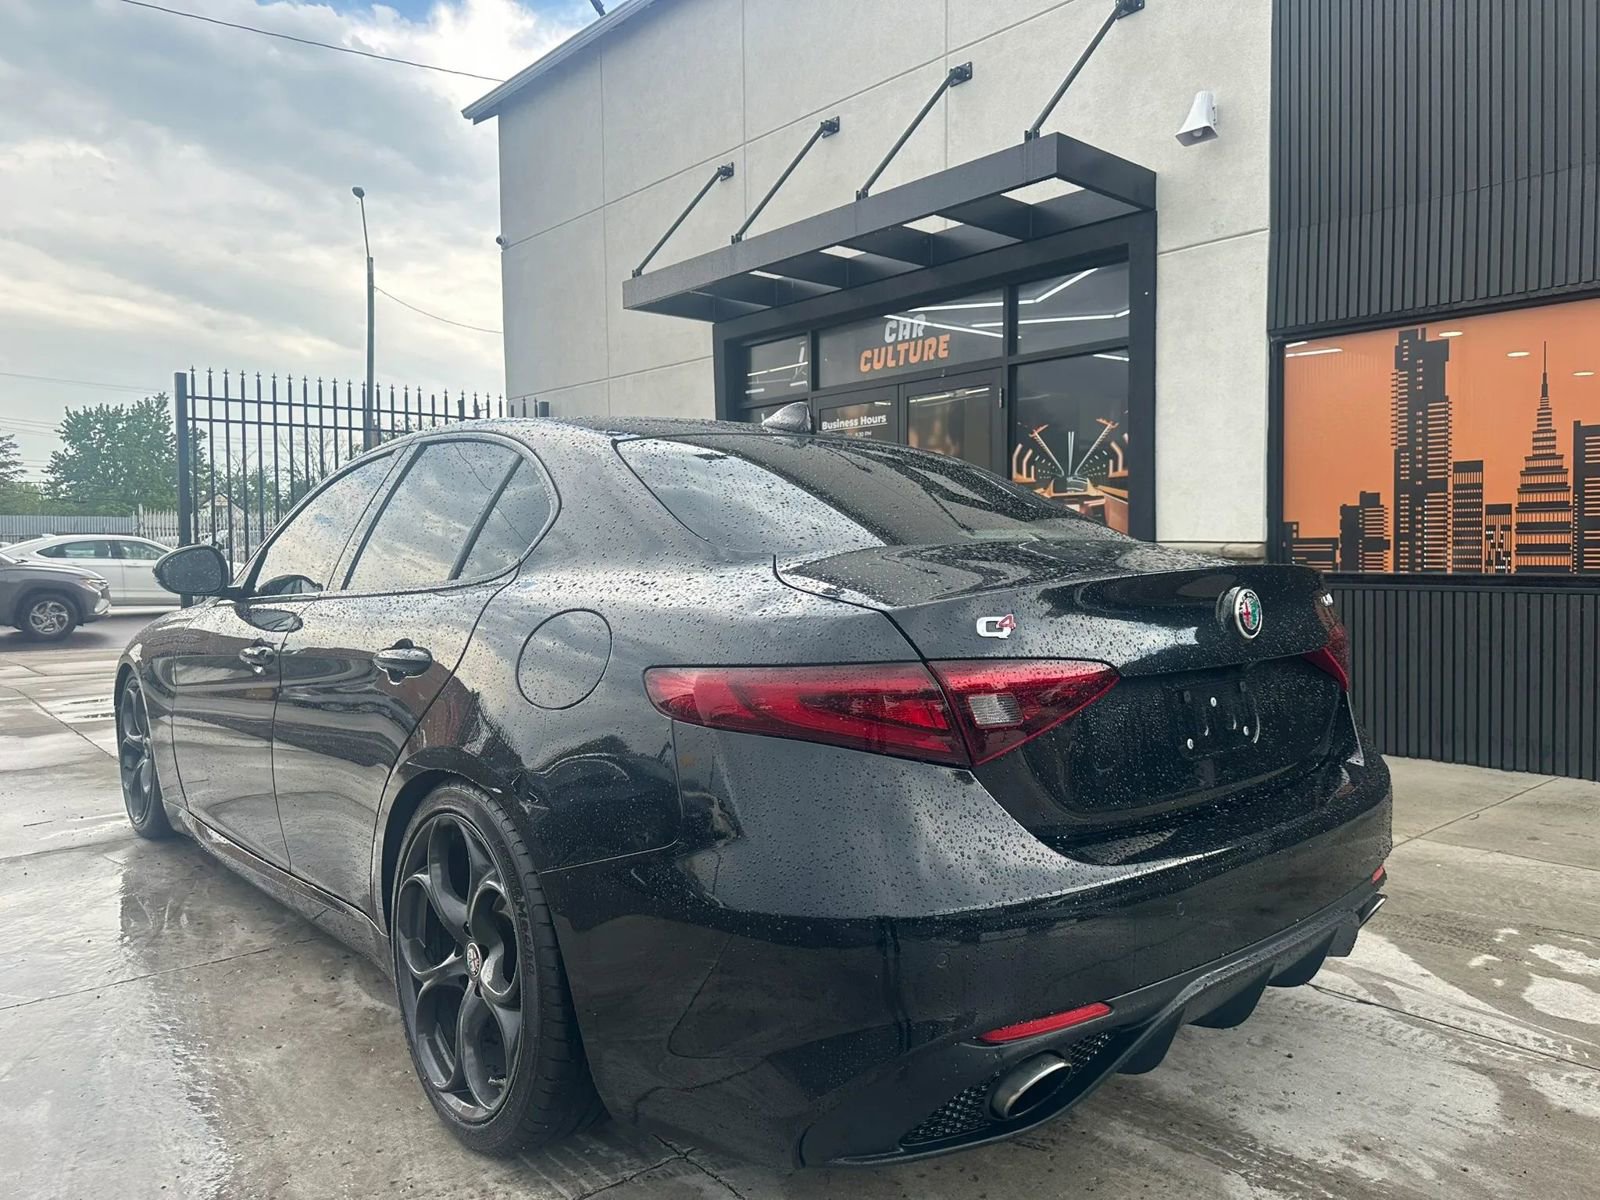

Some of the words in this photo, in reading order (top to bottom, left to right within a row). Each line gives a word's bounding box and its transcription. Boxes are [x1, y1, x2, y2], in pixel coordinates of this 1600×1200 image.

[884, 313, 926, 343] CAR
[860, 334, 950, 373] CULTURE
[821, 418, 859, 431] Business
[860, 414, 887, 426] Hours
[976, 613, 1017, 639] Q4
